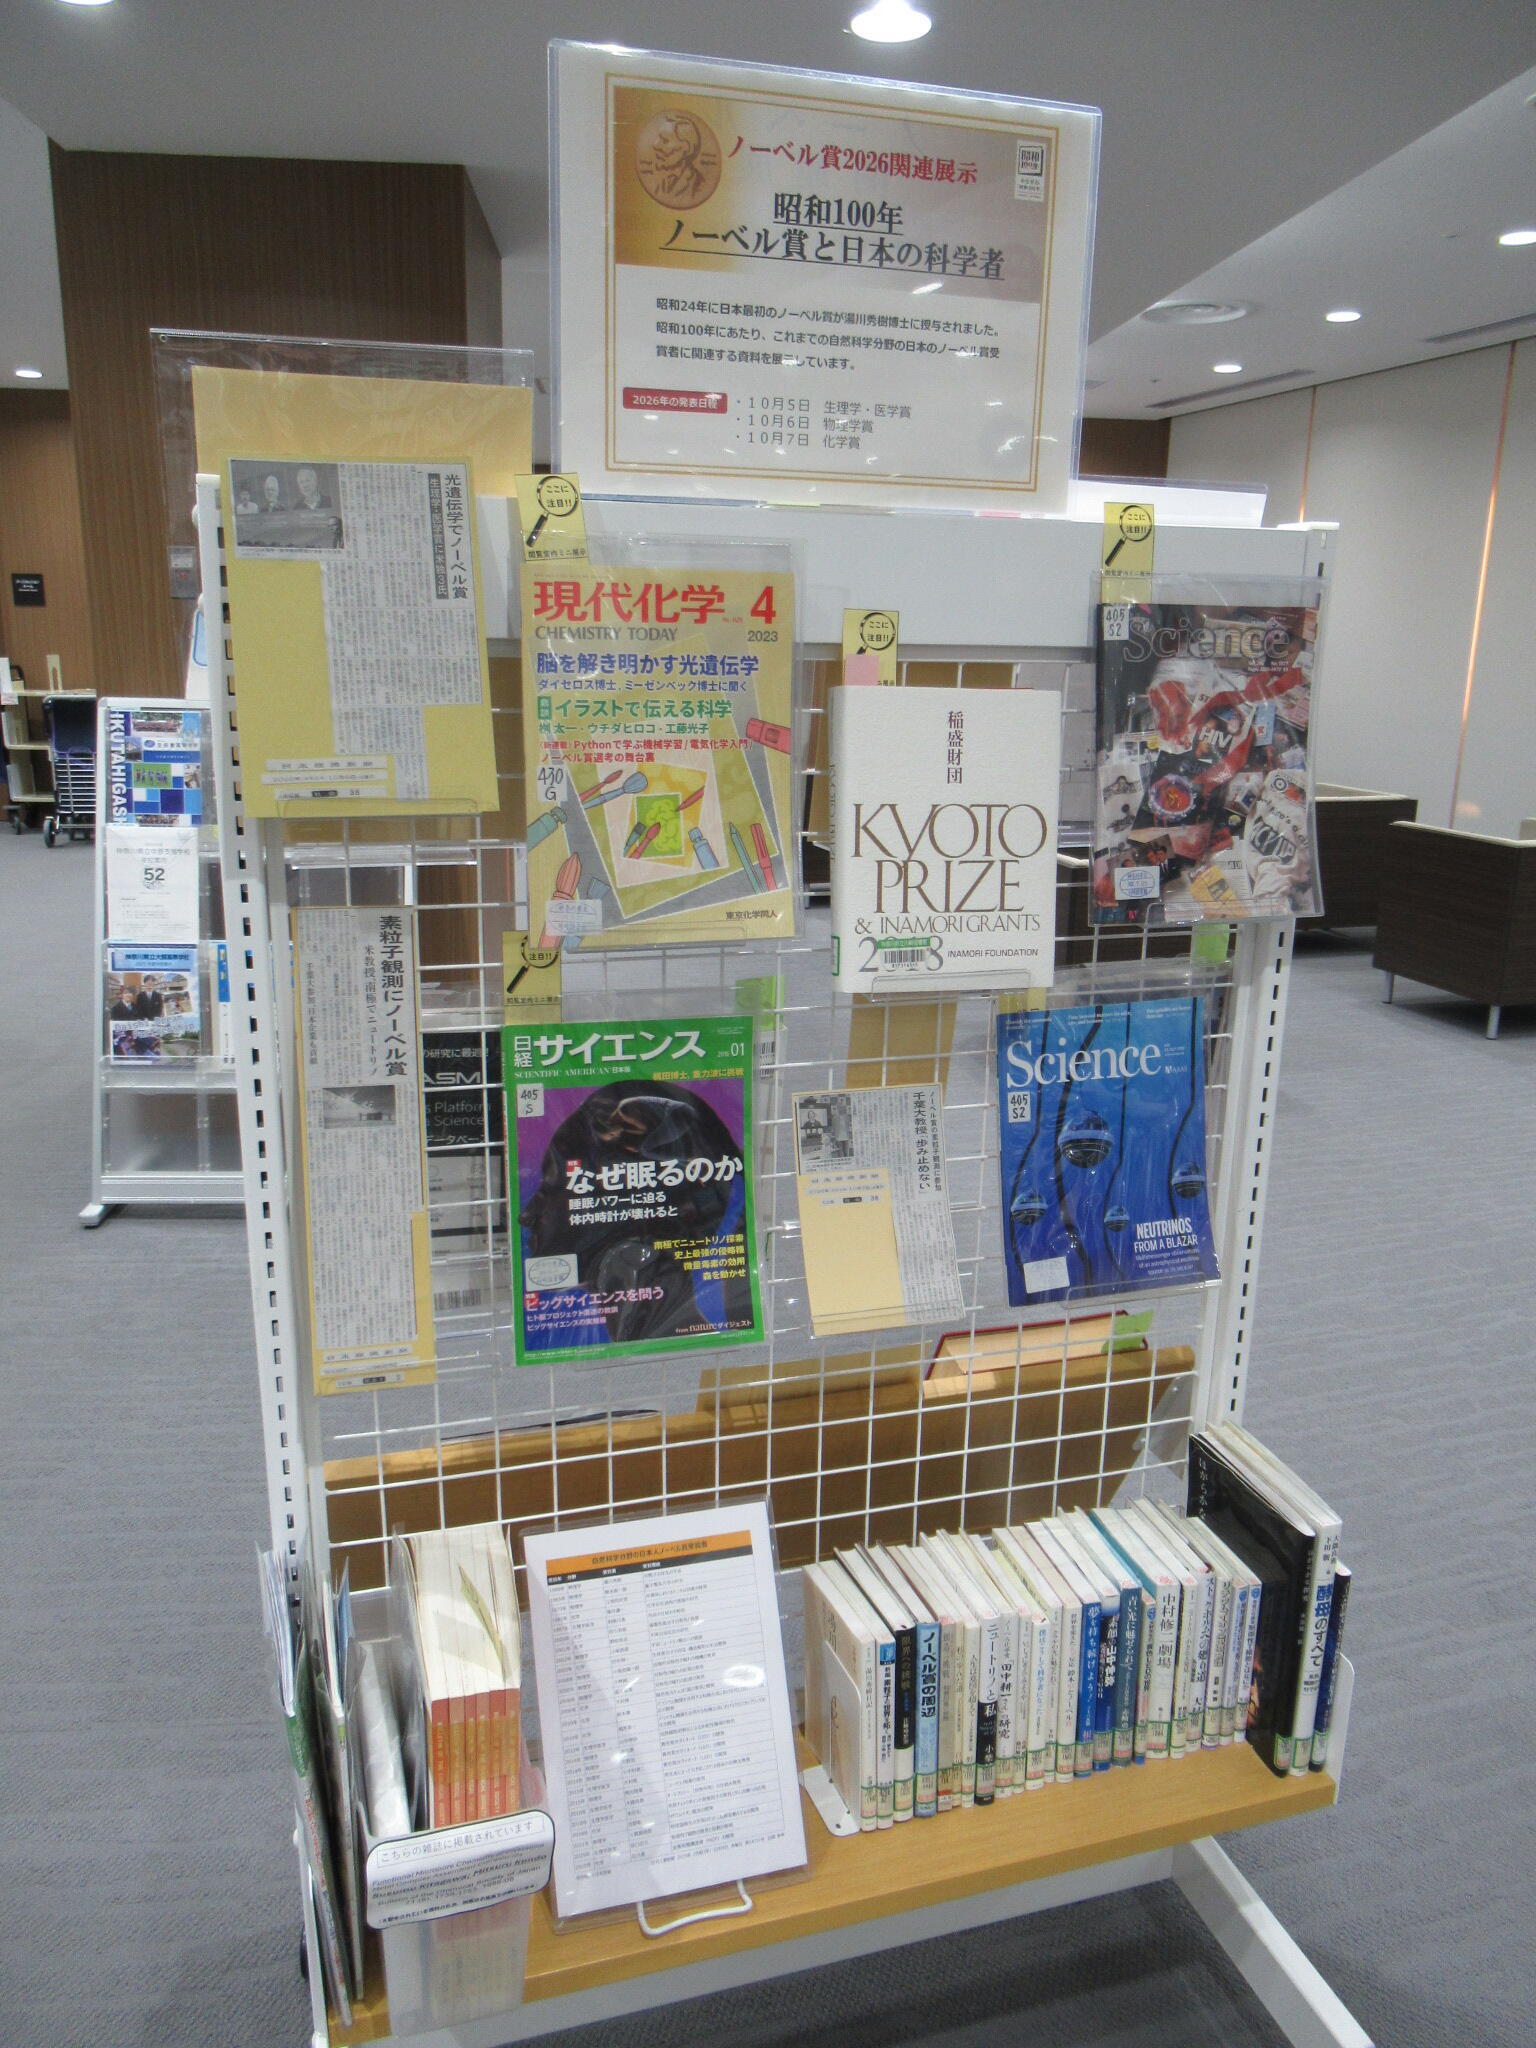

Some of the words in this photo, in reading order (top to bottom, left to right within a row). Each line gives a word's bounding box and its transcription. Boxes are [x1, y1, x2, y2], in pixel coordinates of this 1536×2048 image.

[727, 135, 978, 185] ノーベル賞2026関連展示
[773, 192, 904, 233] 昭和100年
[663, 219, 1006, 279] ノーベル賞と日本の科学者
[823, 400, 912, 419] 生理学・医学賞
[823, 417, 874, 434] 物理学賞
[823, 434, 862, 450] 化学賞
[546, 485, 569, 493] ここに
[533, 580, 725, 624] 現代化学
[750, 586, 776, 624] 4
[869, 621, 889, 629] ここに
[1105, 608, 1125, 622] 405
[535, 625, 621, 641] CHEMISTRY
[628, 627, 678, 642] TODAY
[747, 630, 779, 643] 2023
[1123, 616, 1291, 663] Science
[536, 653, 759, 677] 脳を解き明かす光遺伝学
[555, 699, 733, 719] イラストで伝える科学
[946, 710, 964, 785] 稲盛財団
[1199, 727, 1233, 748] HIV
[537, 767, 564, 786] 430
[545, 787, 557, 801] G
[851, 803, 1048, 859] KYOTO
[144, 867, 165, 881] 52
[874, 859, 1024, 914] PRIZE
[855, 916, 872, 934] &
[880, 914, 963, 935] INAMORI
[965, 913, 1041, 933] GRANTS
[947, 949, 983, 959] INAMORI
[985, 948, 1039, 958] FOUNDATION
[379, 915, 407, 1077] 素粒子観測にノーベル賞
[513, 1035, 534, 1068] 日経
[533, 1031, 706, 1066] サイエンス
[730, 1042, 745, 1057] 01
[513, 1069, 560, 1079] SCIENTIFIC
[564, 1066, 609, 1076] AMERICAN
[1006, 1037, 1162, 1089] Science
[520, 1089, 540, 1101] 405
[1009, 1093, 1029, 1107] 405
[1012, 1106, 1027, 1120] S2
[566, 1155, 743, 1195] なぜ眠るのか
[568, 1191, 667, 1211] 睡眠パワーに迫る
[568, 1205, 679, 1227] 体内時計が壊れると
[1136, 1216, 1193, 1240] NEUTRINOS
[1134, 1240, 1158, 1253] FROM
[1159, 1239, 1166, 1250] A
[1166, 1233, 1199, 1248] BLAZAR
[526, 1287, 665, 1312] ビッグサイエンスを問う
[1156, 1592, 1177, 1670] 中村修二劇場
[1310, 1583, 1334, 1667] 酵母のすべて
[920, 1631, 938, 1718] ノーベル賞の周辺
[381, 1820, 534, 1863] こちらの雑誌に掲載されています
